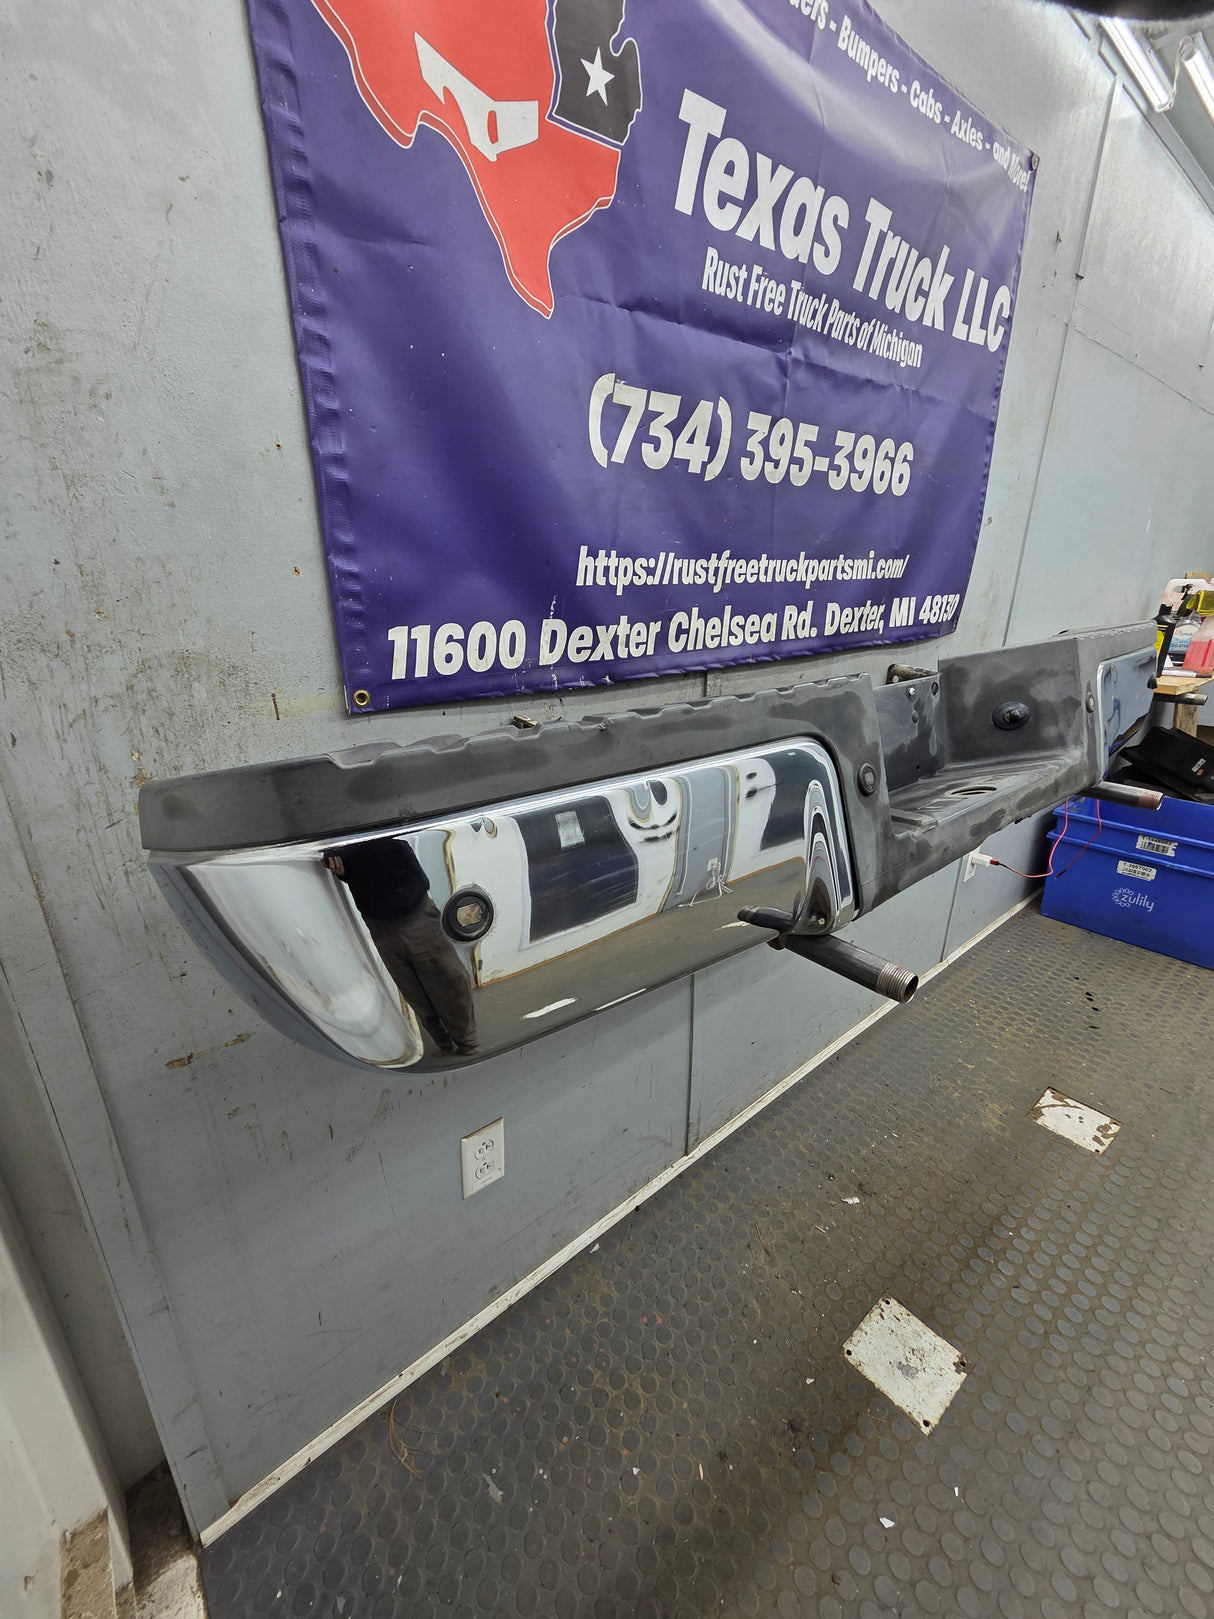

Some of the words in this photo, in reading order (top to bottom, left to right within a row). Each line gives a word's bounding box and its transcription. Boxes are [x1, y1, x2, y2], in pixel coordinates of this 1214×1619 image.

[837, 14, 900, 94] Bumpers
[909, 80, 943, 124] Cabs
[950, 110, 983, 151] Axles
[992, 141, 1010, 173] and
[1007, 152, 1032, 193] More!
[674, 88, 850, 276] Texas
[852, 197, 955, 332] Truck
[951, 268, 1011, 353] LLC
[701, 246, 748, 303] Rust
[746, 264, 787, 316] Free
[787, 279, 829, 333] Truck
[823, 299, 861, 346] Parts
[856, 318, 876, 352] of
[868, 320, 923, 368] Michigan
[588, 372, 732, 482] (734)
[740, 411, 914, 497] 395-3966
[576, 545, 910, 596] https://rustfreetruckpartsmi.com/
[387, 619, 527, 680] 11600
[538, 615, 662, 666] Dexter
[667, 604, 778, 653] Chelsea
[781, 601, 818, 640] Rd.
[823, 600, 886, 636] Dexter,
[888, 597, 917, 628] MI
[918, 593, 961, 625] 48130
[1120, 892, 1155, 912] zulily
